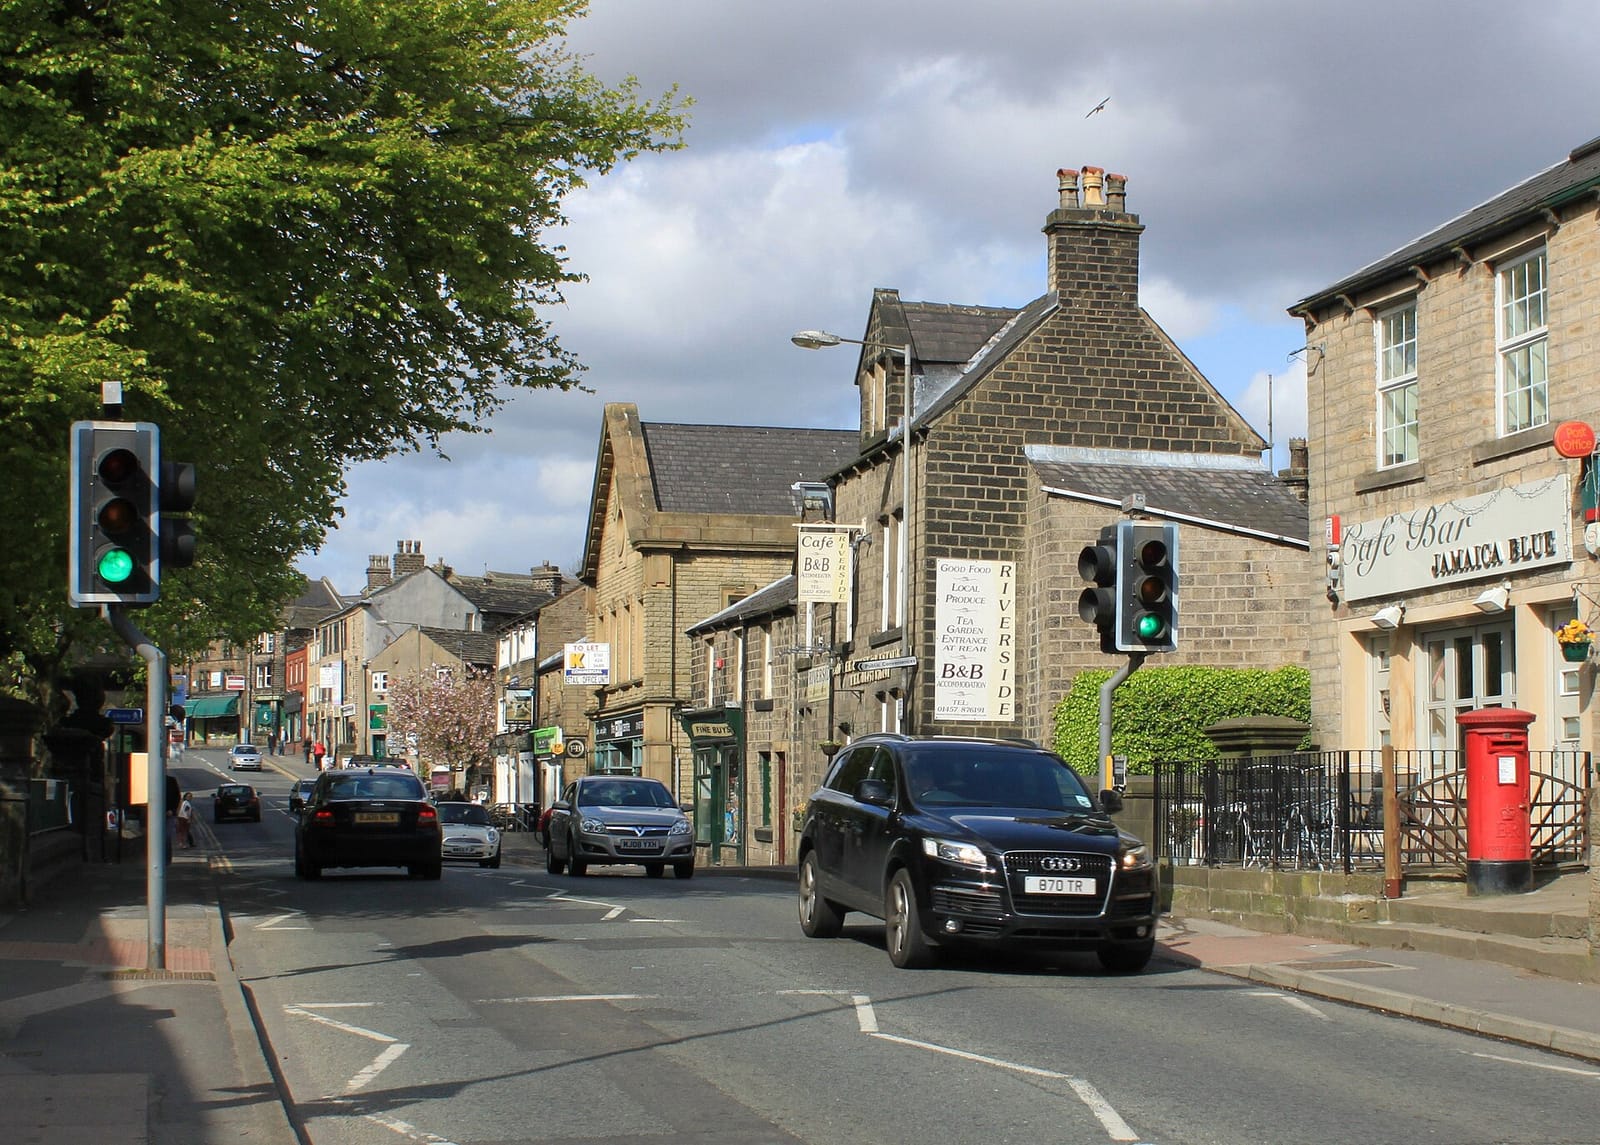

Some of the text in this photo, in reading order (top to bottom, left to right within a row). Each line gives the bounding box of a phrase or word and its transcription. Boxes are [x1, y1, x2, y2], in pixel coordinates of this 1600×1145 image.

[1566, 427, 1587, 438] Post
[1562, 439, 1592, 450] Office
[1406, 505, 1472, 551] Bar
[801, 535, 834, 550] Café
[1431, 530, 1557, 578] JAMAICA BLUE
[804, 557, 830, 572] B&B
[838, 536, 846, 600] RIVERSIDE
[940, 563, 992, 574] GOOD FOOD
[951, 583, 980, 592] LOCAL
[945, 594, 986, 604] PRODUCE
[956, 616, 974, 625] TEA
[946, 625, 984, 634] GARDEN
[941, 634, 989, 644] ENTRANCE
[998, 564, 1012, 716] RIVERSIDE
[941, 663, 983, 680] B&B
[936, 680, 986, 688] ACCOMMODATION
[696, 726, 731, 734] FINE BUYS
[1067, 880, 1083, 893] TR
